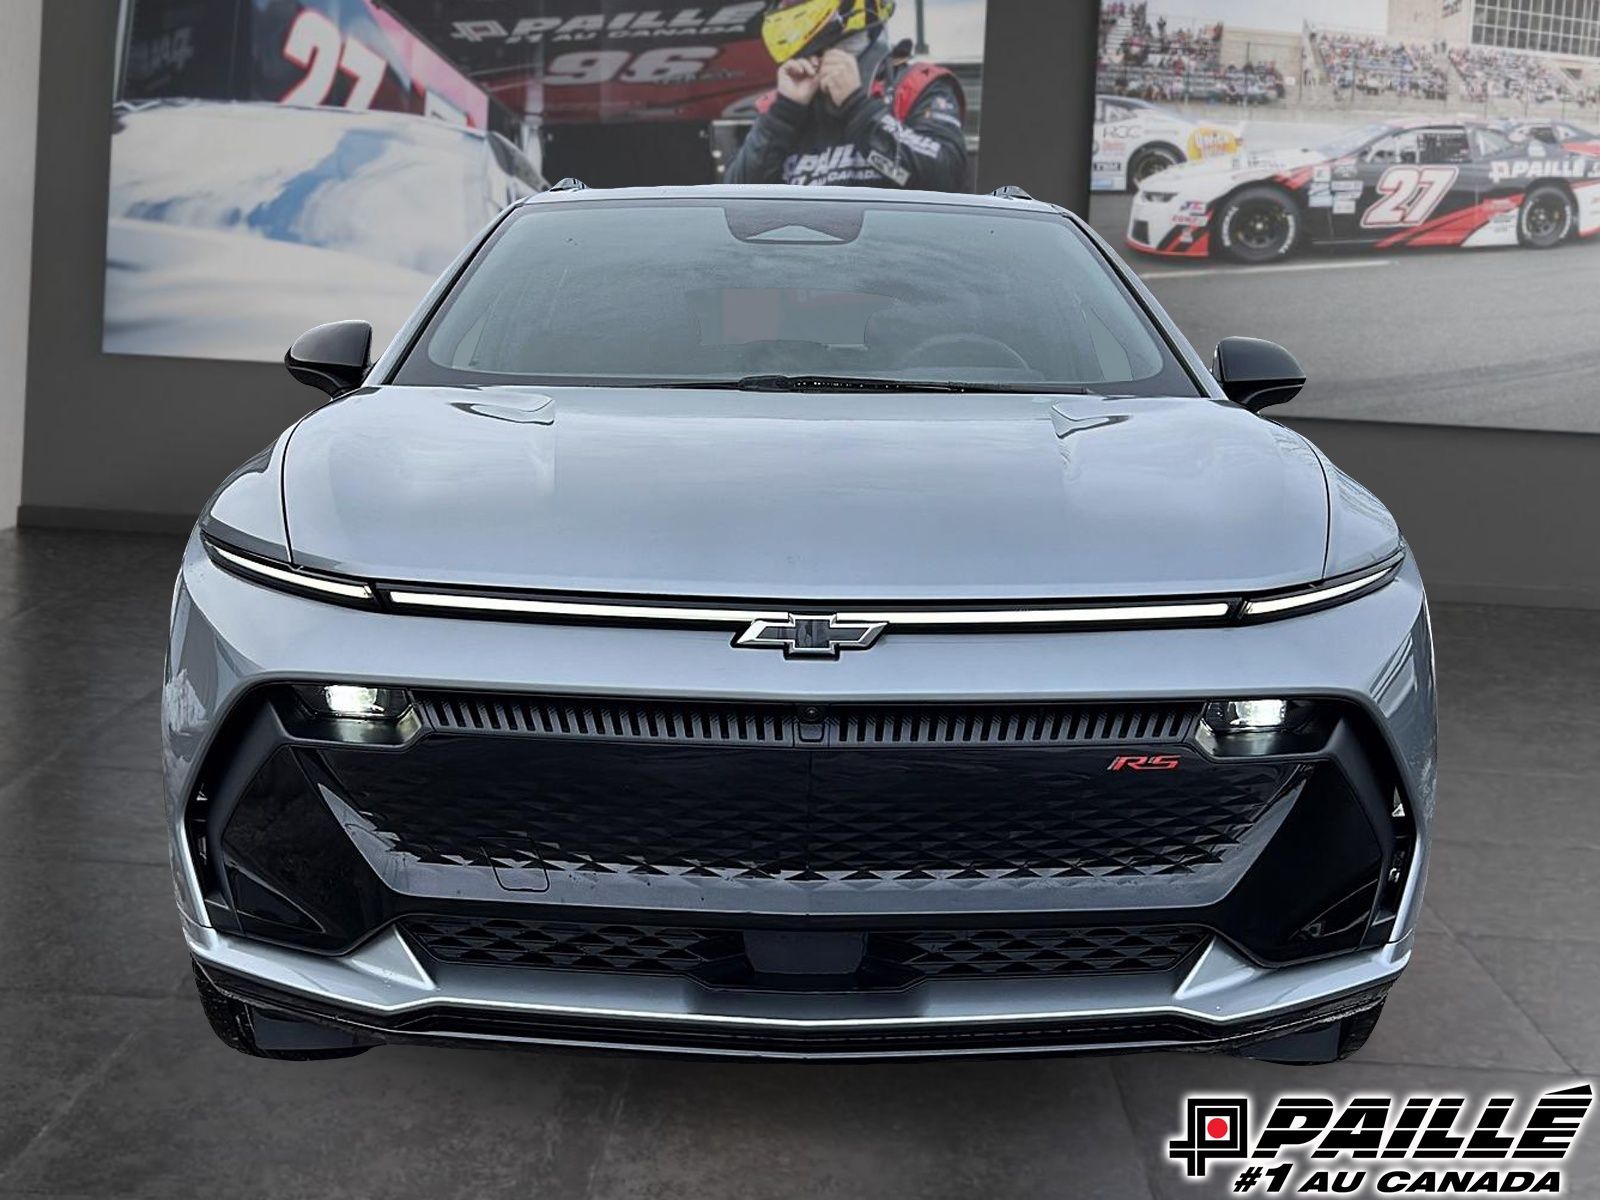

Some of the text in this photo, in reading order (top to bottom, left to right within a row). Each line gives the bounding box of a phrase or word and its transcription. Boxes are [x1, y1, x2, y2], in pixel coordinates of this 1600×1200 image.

[280, 8, 388, 112] 27
[543, 46, 719, 86] 96
[1360, 164, 1460, 229] 27
[1106, 755, 1182, 771] RS
